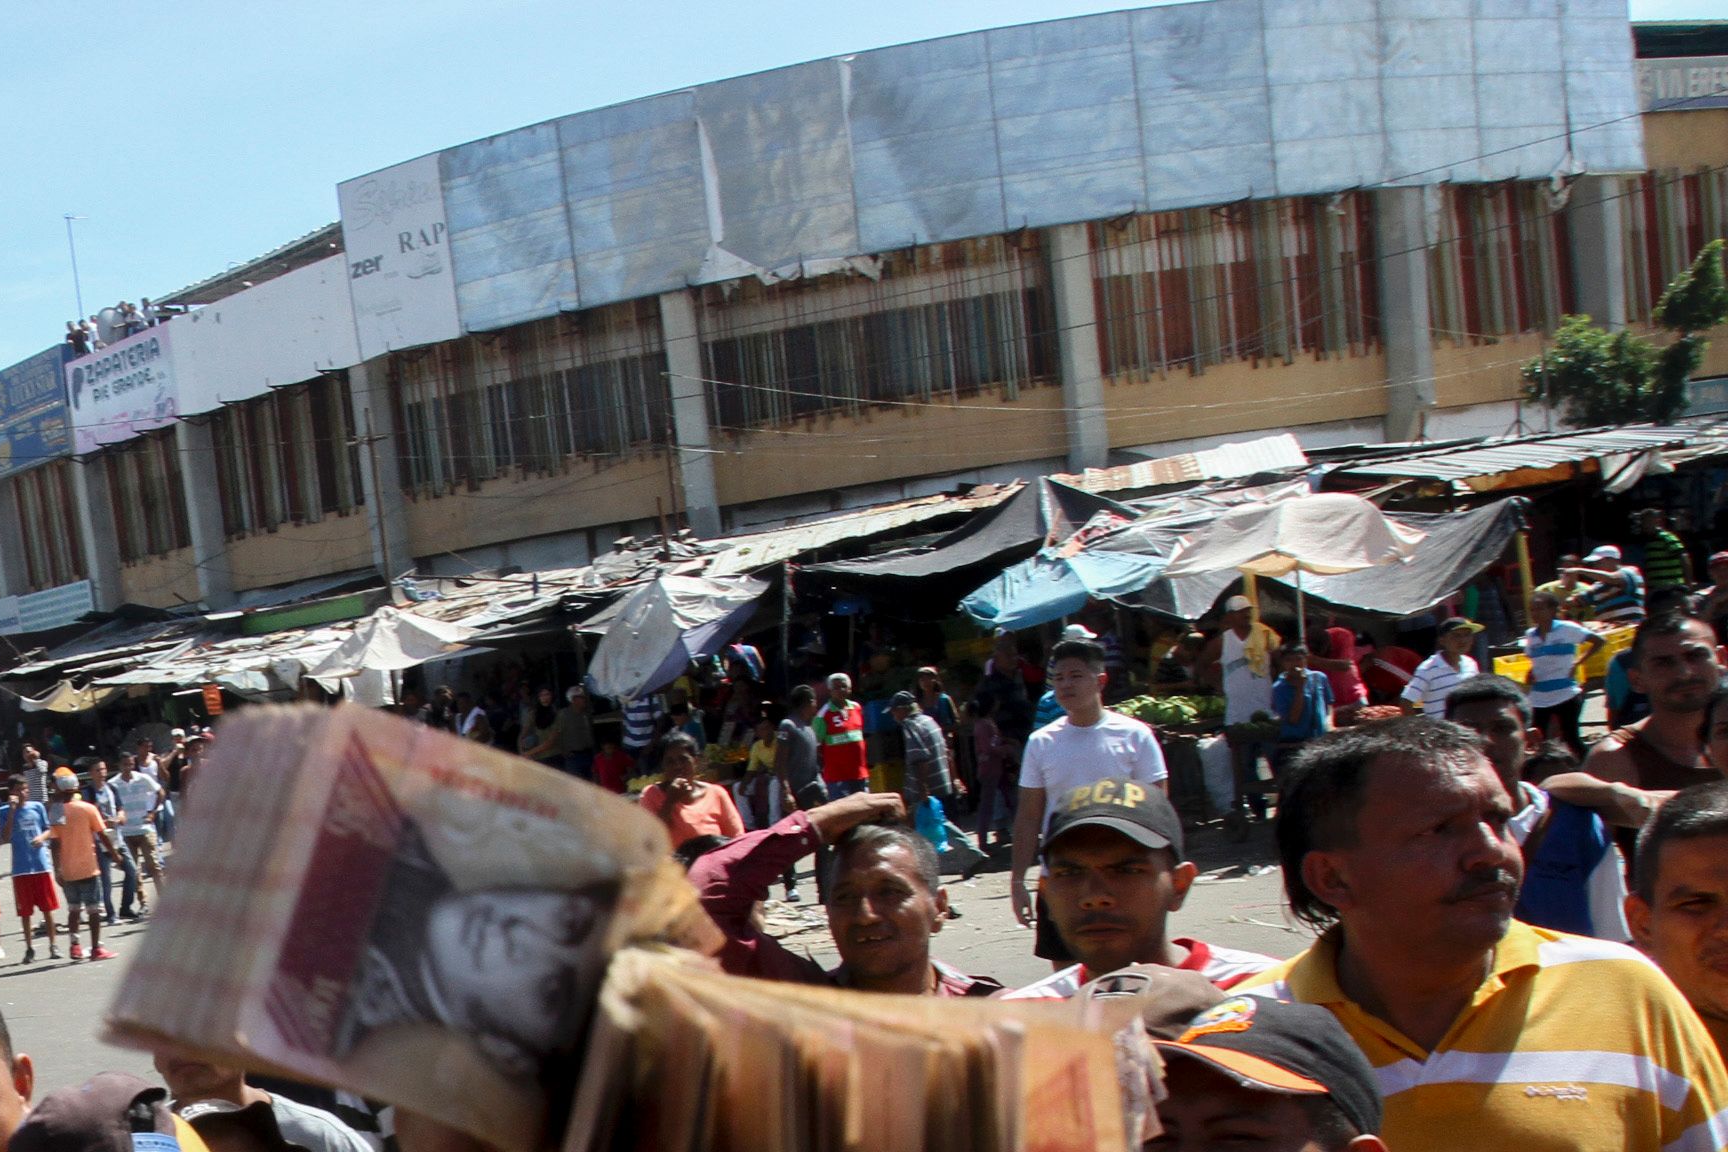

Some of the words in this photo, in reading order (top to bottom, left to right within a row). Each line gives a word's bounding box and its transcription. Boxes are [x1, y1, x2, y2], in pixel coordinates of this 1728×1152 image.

[398, 222, 445, 254] RAP
[351, 254, 383, 279] zer
[85, 337, 160, 385] ZAPATERIA
